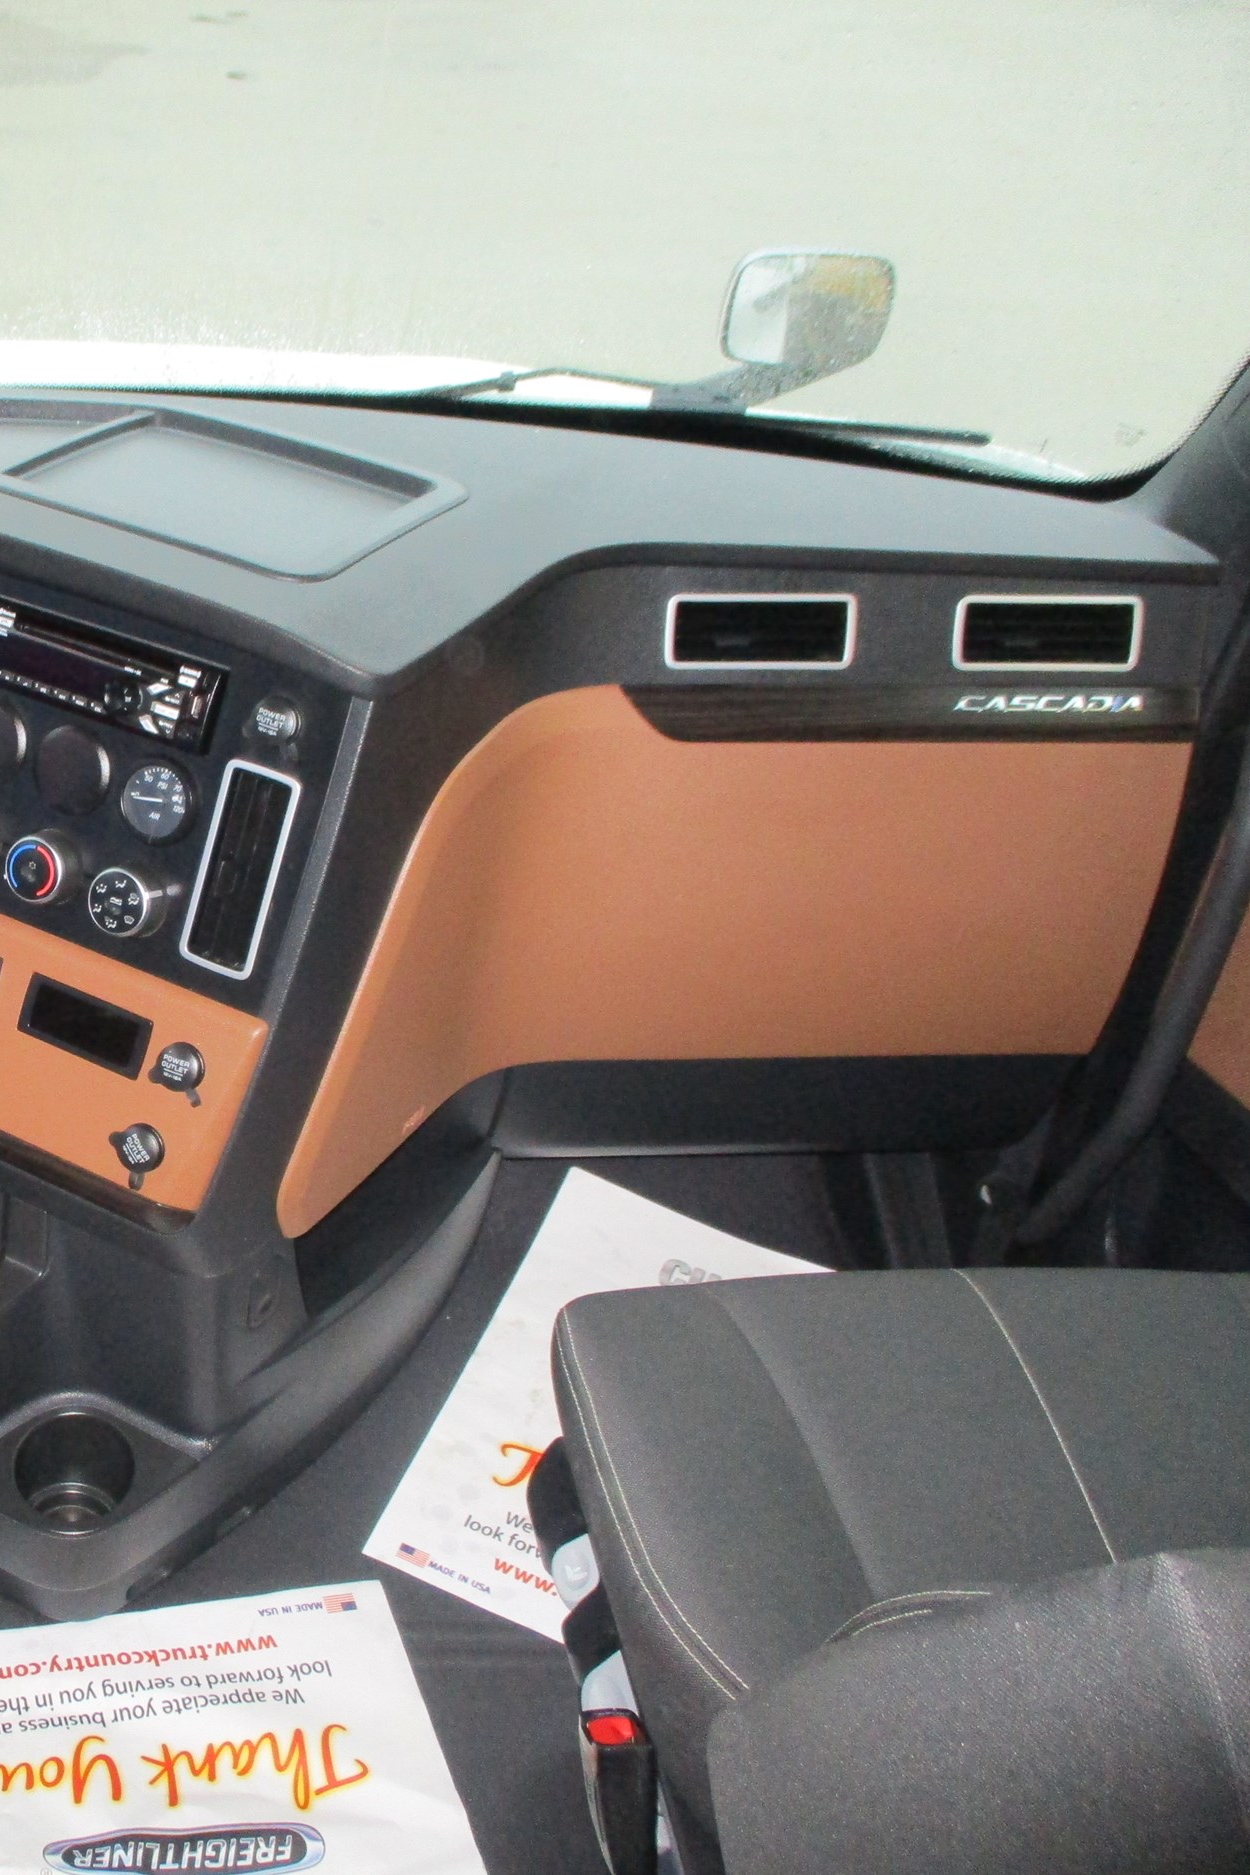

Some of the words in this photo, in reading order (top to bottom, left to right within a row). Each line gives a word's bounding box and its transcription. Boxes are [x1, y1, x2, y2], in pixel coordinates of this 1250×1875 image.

[258, 706, 286, 722] POWER
[952, 694, 1144, 714] CASCADIA
[256, 714, 284, 729] OUTLET
[161, 1060, 189, 1076] OUTLET
[163, 1053, 191, 1068] POWER
[126, 1136, 145, 1164] OUTLET
[131, 1133, 151, 1163] POWER
[463, 1514, 505, 1542] look
[505, 1511, 534, 1534] We
[428, 1560, 456, 1579] MADE
[457, 1573, 469, 1584] IN
[471, 1578, 492, 1595] USA
[257, 1606, 280, 1618] USA
[281, 1605, 293, 1614] IN
[295, 1601, 324, 1613] MADE
[180, 1674, 202, 1688] to
[206, 1665, 285, 1690] forward
[286, 1659, 333, 1682] look
[59, 1680, 95, 1704] you
[101, 1675, 175, 1699] serving
[271, 1687, 306, 1706] We
[34, 1692, 54, 1711] in
[111, 1697, 158, 1724] your
[162, 1687, 266, 1715] appreciate
[18, 1711, 107, 1732] business
[140, 1723, 370, 1810] Thank
[72, 1833, 293, 1873] FREIGHTLINER
